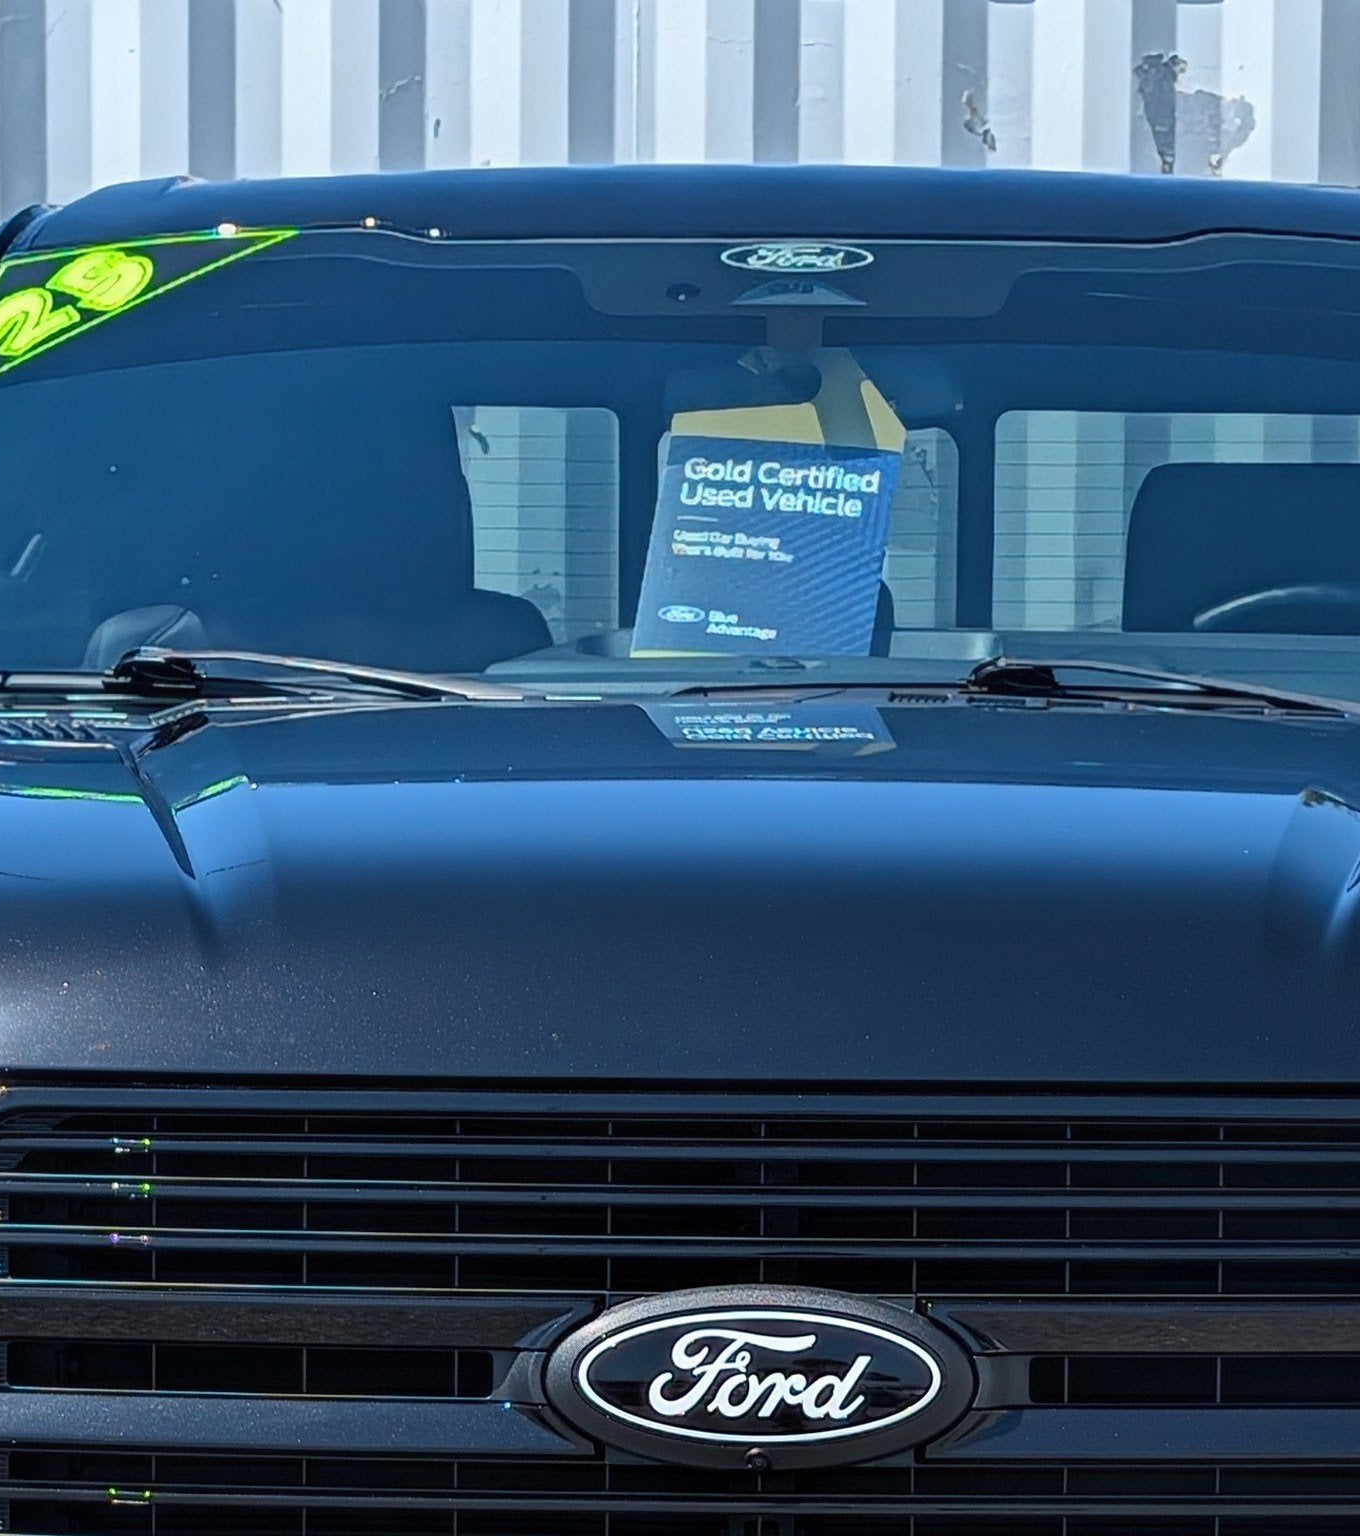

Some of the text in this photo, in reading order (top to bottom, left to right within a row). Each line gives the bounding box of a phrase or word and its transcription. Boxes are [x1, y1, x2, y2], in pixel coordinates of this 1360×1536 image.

[747, 248, 845, 268] Ford
[684, 457, 881, 494] Gold Certified
[680, 482, 863, 517] Used Vehicle
[709, 610, 738, 624] Blue
[706, 623, 777, 640] Advantage
[648, 1328, 873, 1420] Ford
